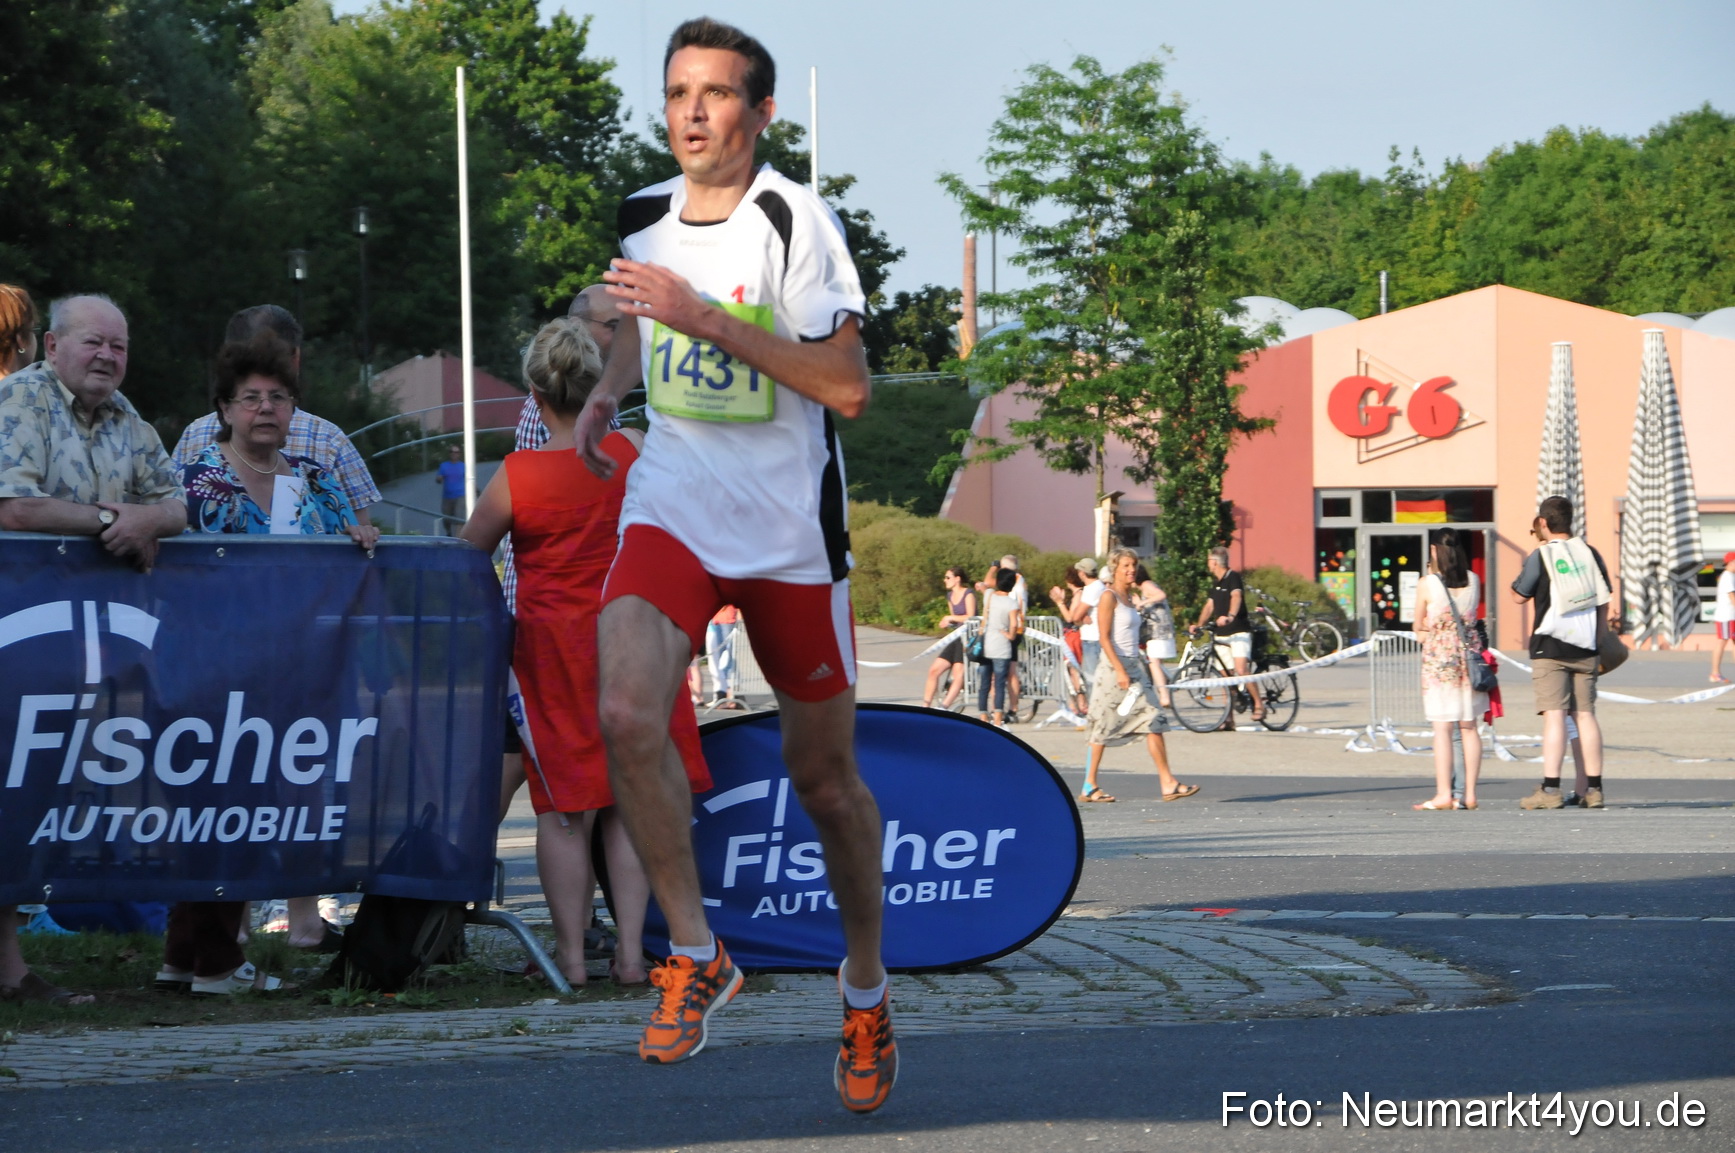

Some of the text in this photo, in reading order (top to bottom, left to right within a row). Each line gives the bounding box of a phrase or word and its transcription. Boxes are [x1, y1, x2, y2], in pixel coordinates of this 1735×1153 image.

[656, 338, 759, 391] 1431
[5, 691, 379, 788] Fischer
[29, 805, 347, 845] AUTOMOBILE
[722, 819, 1017, 888] Fisher
[751, 878, 994, 918] AUTOOBILE
